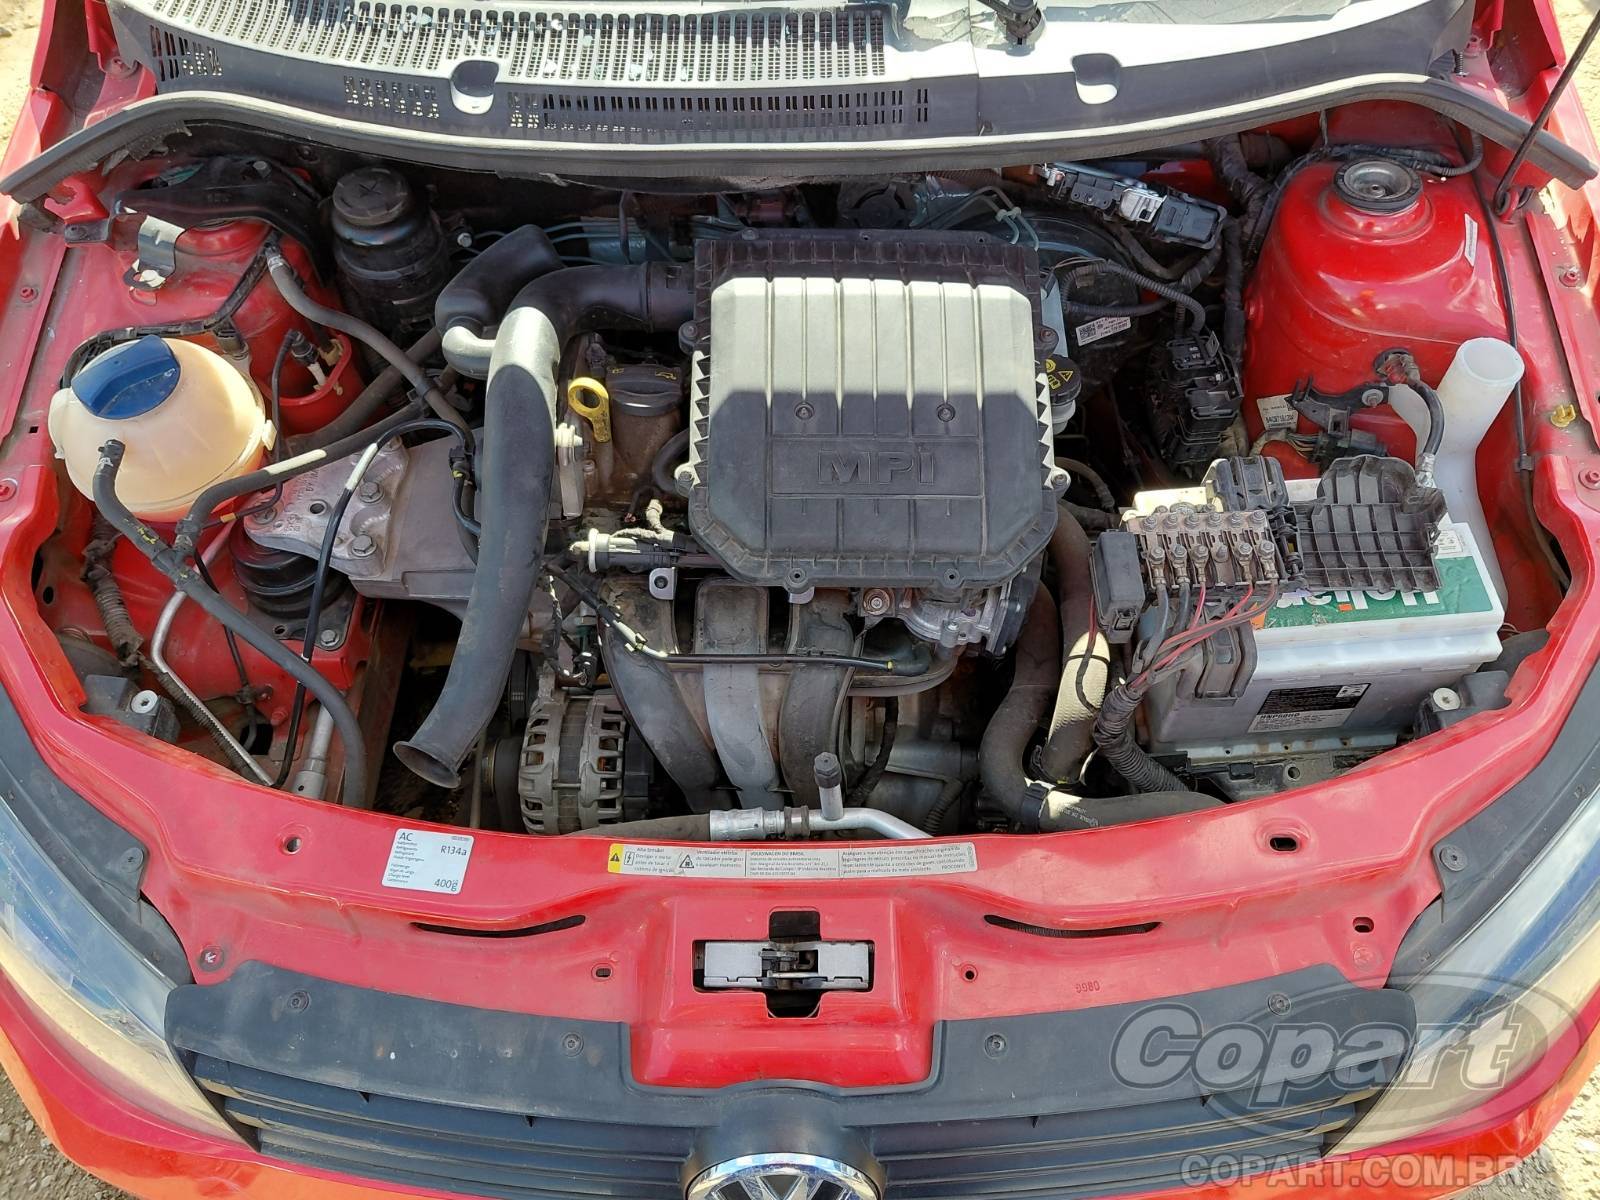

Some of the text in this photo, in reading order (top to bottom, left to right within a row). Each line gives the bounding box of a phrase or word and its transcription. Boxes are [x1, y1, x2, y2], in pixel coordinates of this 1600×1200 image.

[399, 832, 413, 842] AC
[440, 845, 467, 856] R134a
[434, 878, 458, 892] 400g
